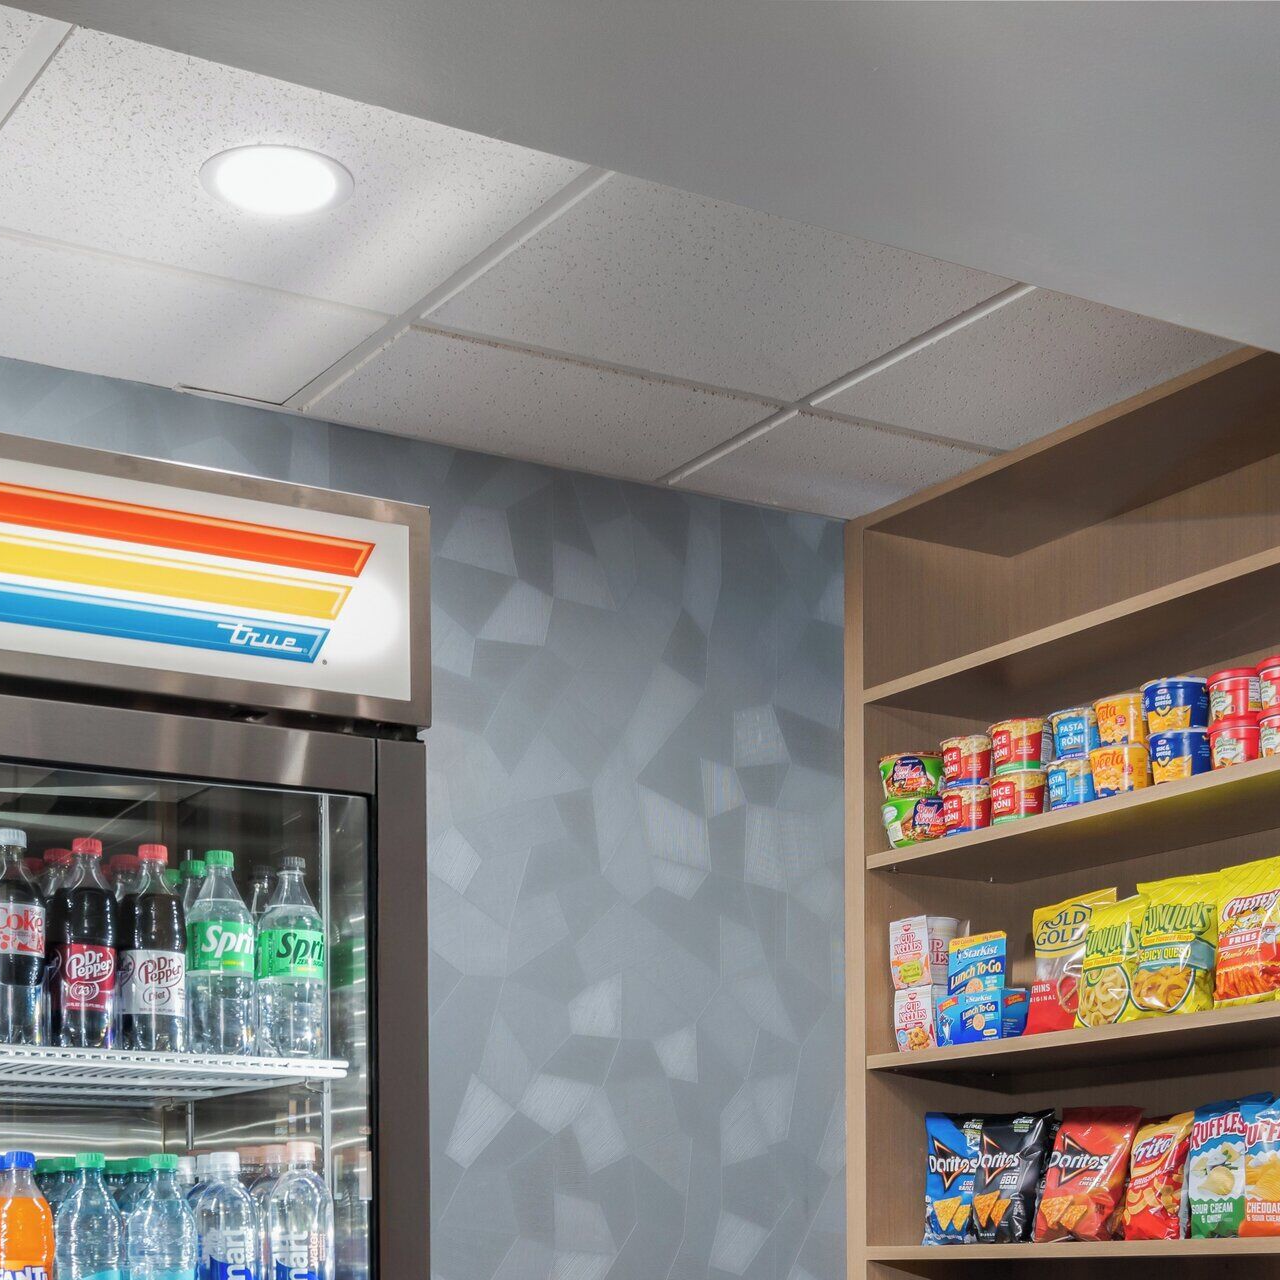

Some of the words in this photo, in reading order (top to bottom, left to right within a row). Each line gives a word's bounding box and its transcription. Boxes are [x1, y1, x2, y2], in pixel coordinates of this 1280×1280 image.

[217, 621, 304, 654] true
[1060, 723, 1084, 732] PASTA
[993, 734, 1007, 744] RICE
[1062, 736, 1084, 747] RONI
[943, 752, 957, 761] RICE
[994, 750, 1008, 760] RONI
[992, 786, 1010, 796] RICE
[943, 800, 958, 808] RICE
[994, 800, 1010, 809] RONI
[1041, 910, 1086, 929] ROLD
[1141, 902, 1215, 937] FUNYUNS
[901, 933, 915, 941] CUP
[1036, 928, 1083, 946] GOLD
[1086, 921, 1139, 955] FUNYUNS
[1177, 933, 1192, 941] Rings
[1229, 933, 1257, 945] FRIES
[894, 942, 922, 955] NOODLES
[963, 945, 998, 959] StarKist
[88, 951, 104, 966] Dr
[1140, 950, 1162, 962] SPICY
[71, 957, 113, 978] Pepper
[160, 955, 174, 970] Dr
[144, 961, 182, 984] Pepper
[951, 968, 974, 989] Lunch
[977, 960, 1001, 974] To-Go
[149, 990, 166, 1001] Diet
[969, 995, 992, 1003] StarKist
[905, 1002, 921, 1010] CUP
[962, 1008, 978, 1020] Lunch
[978, 1004, 995, 1012] To-Go
[899, 1010, 927, 1022] NOODLES
[1192, 1112, 1245, 1150] RUFFLES
[929, 1155, 978, 1174] Doritos
[975, 1151, 1020, 1170] Doritos
[1048, 1151, 1114, 1171] Doritos
[1000, 1176, 1019, 1185] BBQ
[1134, 1167, 1162, 1185] ORIGINAL
[1192, 1203, 1209, 1214] SOUR
[1209, 1202, 1233, 1213] CREAM
[1207, 1215, 1222, 1224] ONION
[310, 1231, 318, 1267] water
